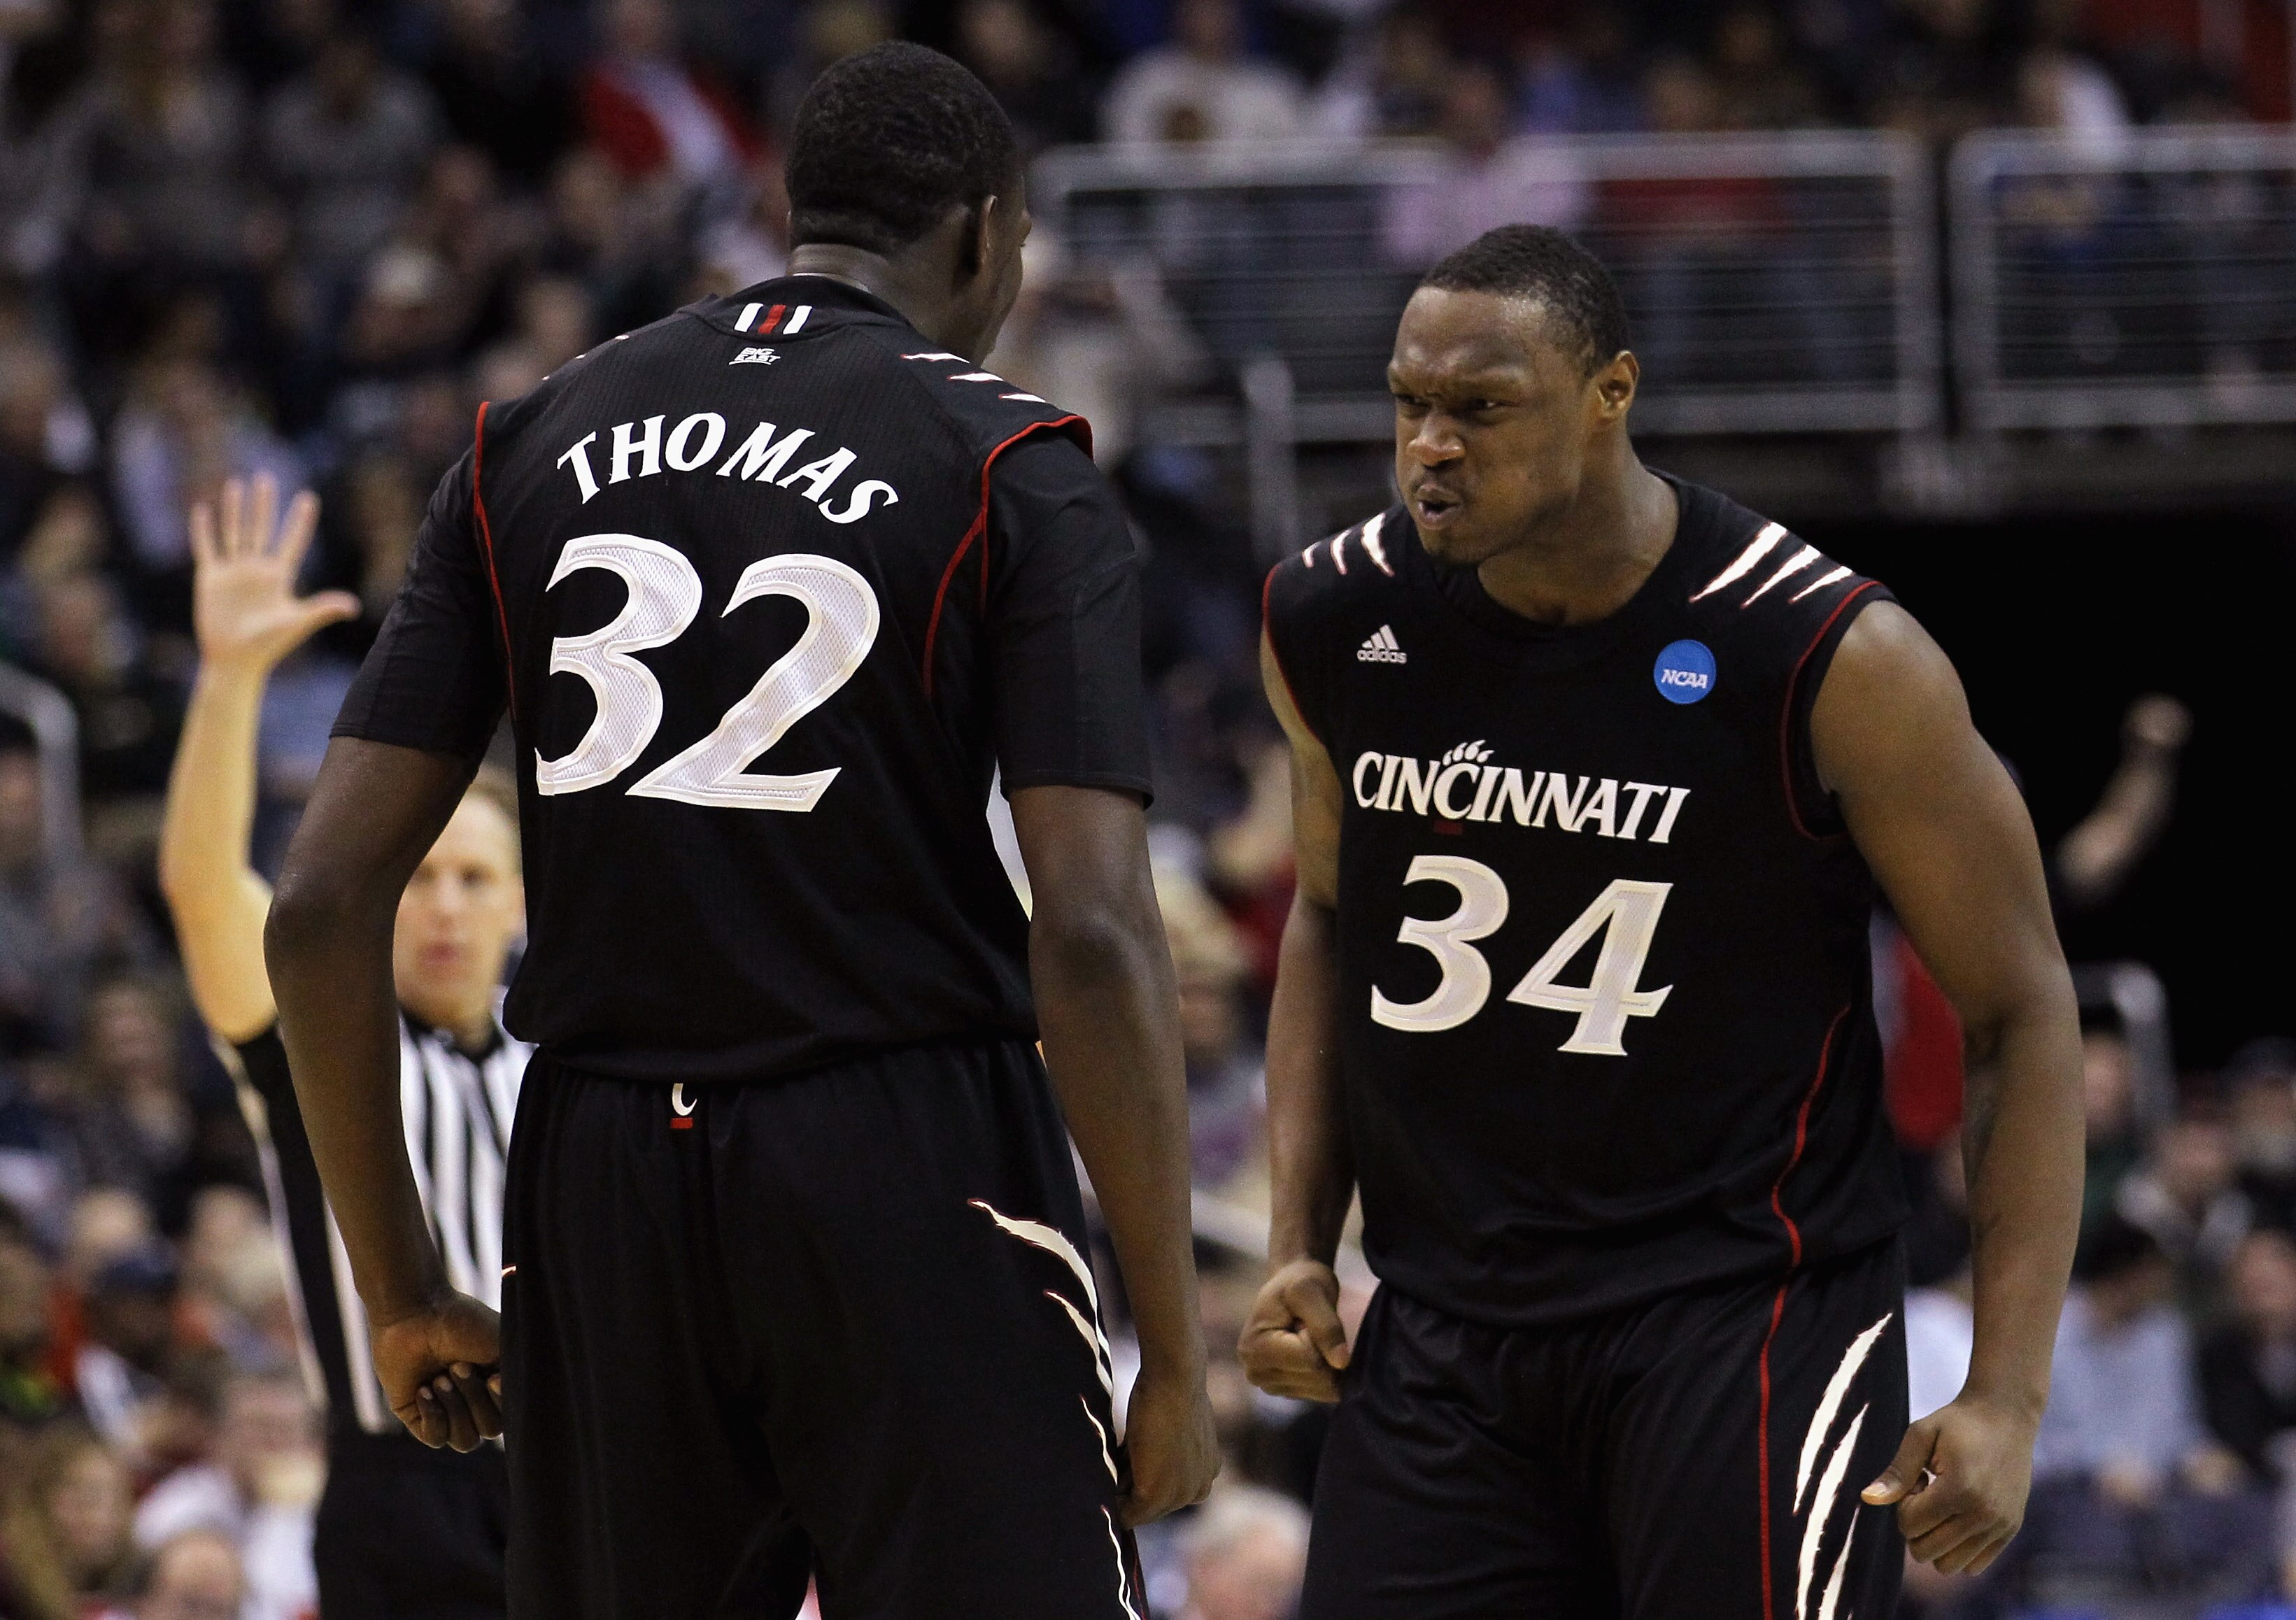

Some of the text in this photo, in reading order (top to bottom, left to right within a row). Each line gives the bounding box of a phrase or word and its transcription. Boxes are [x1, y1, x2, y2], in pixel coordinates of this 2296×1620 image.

[741, 347, 774, 355] BIG
[557, 412, 899, 523] THOMAS
[534, 533, 880, 812] 32
[1357, 649, 1407, 664] adidas
[1661, 668, 1708, 689] NCAA
[1352, 750, 1691, 844] CINCINNATI
[1370, 855, 1673, 1056] 34
